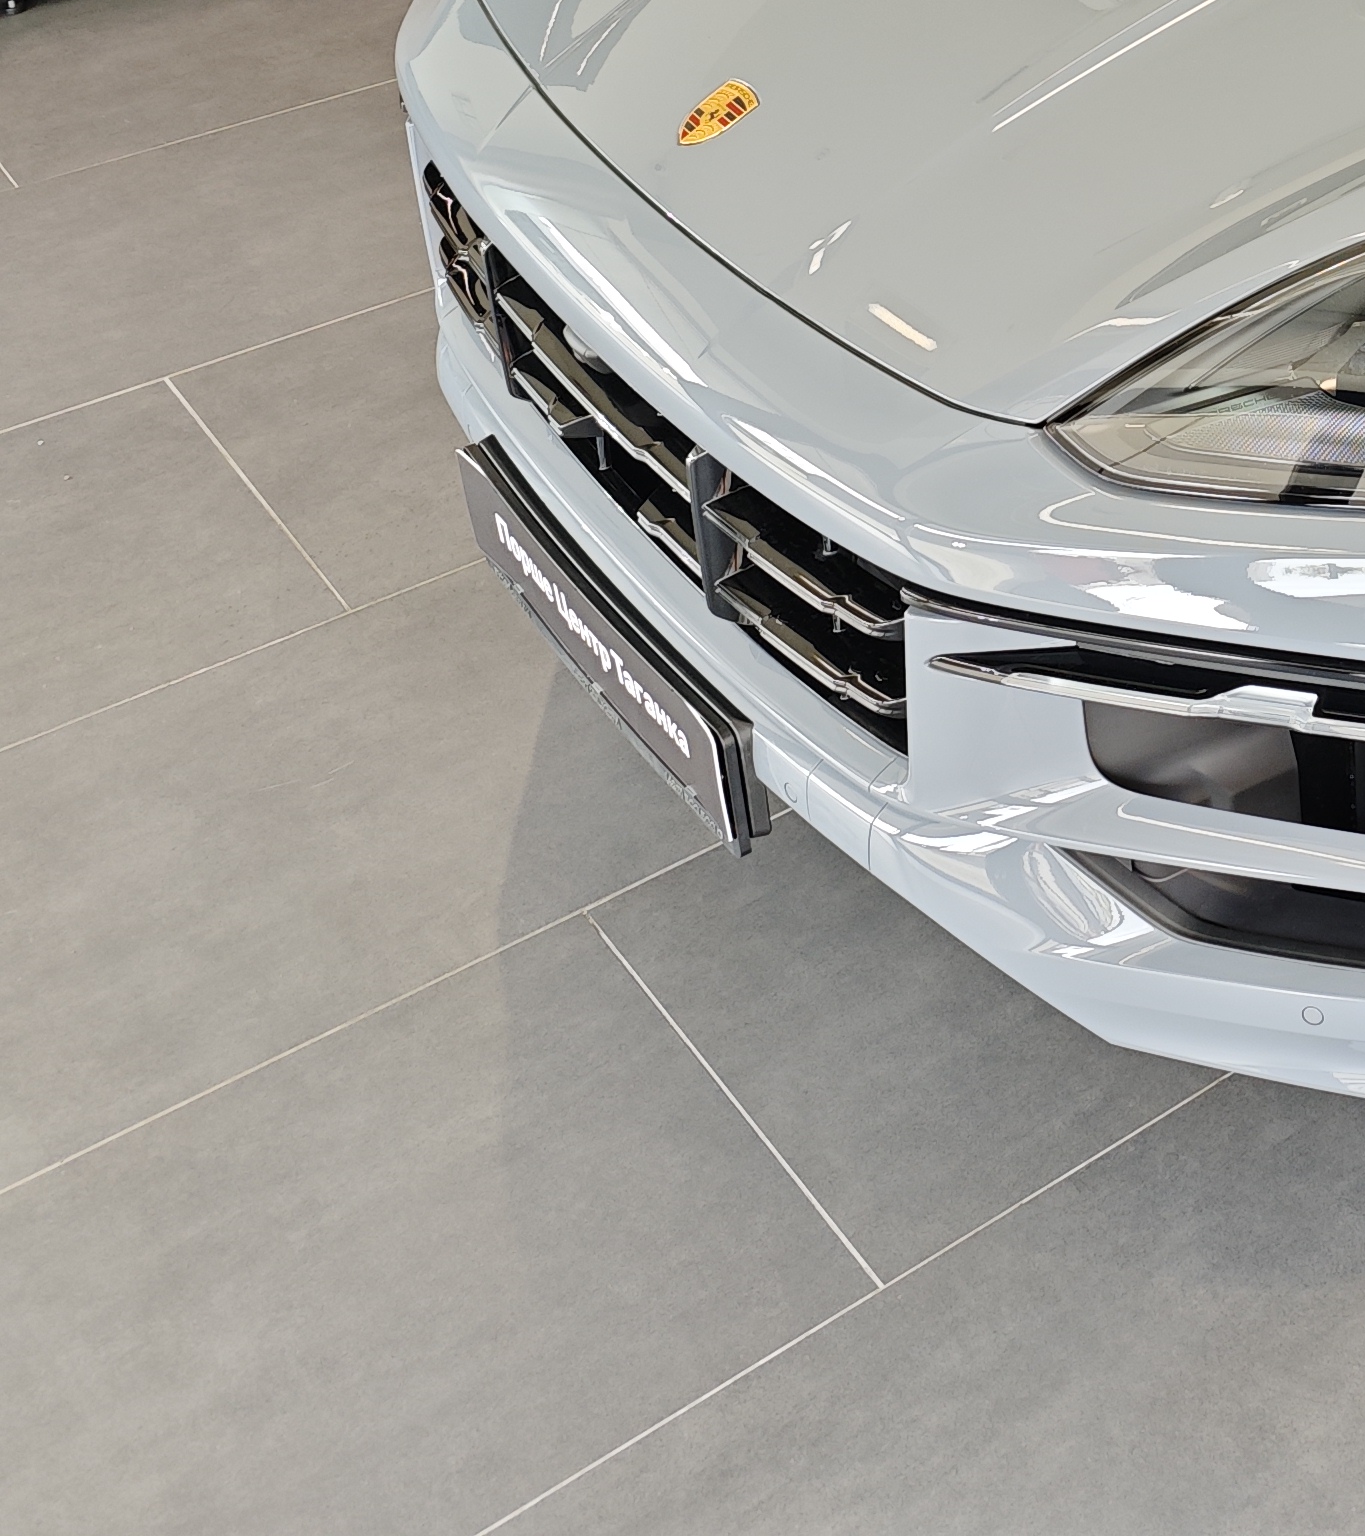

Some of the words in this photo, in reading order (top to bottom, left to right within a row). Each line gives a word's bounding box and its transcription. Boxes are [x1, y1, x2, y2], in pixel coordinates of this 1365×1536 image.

[494, 512, 556, 603] Порше
[552, 582, 614, 674] Центр
[609, 648, 691, 759] Таганка
